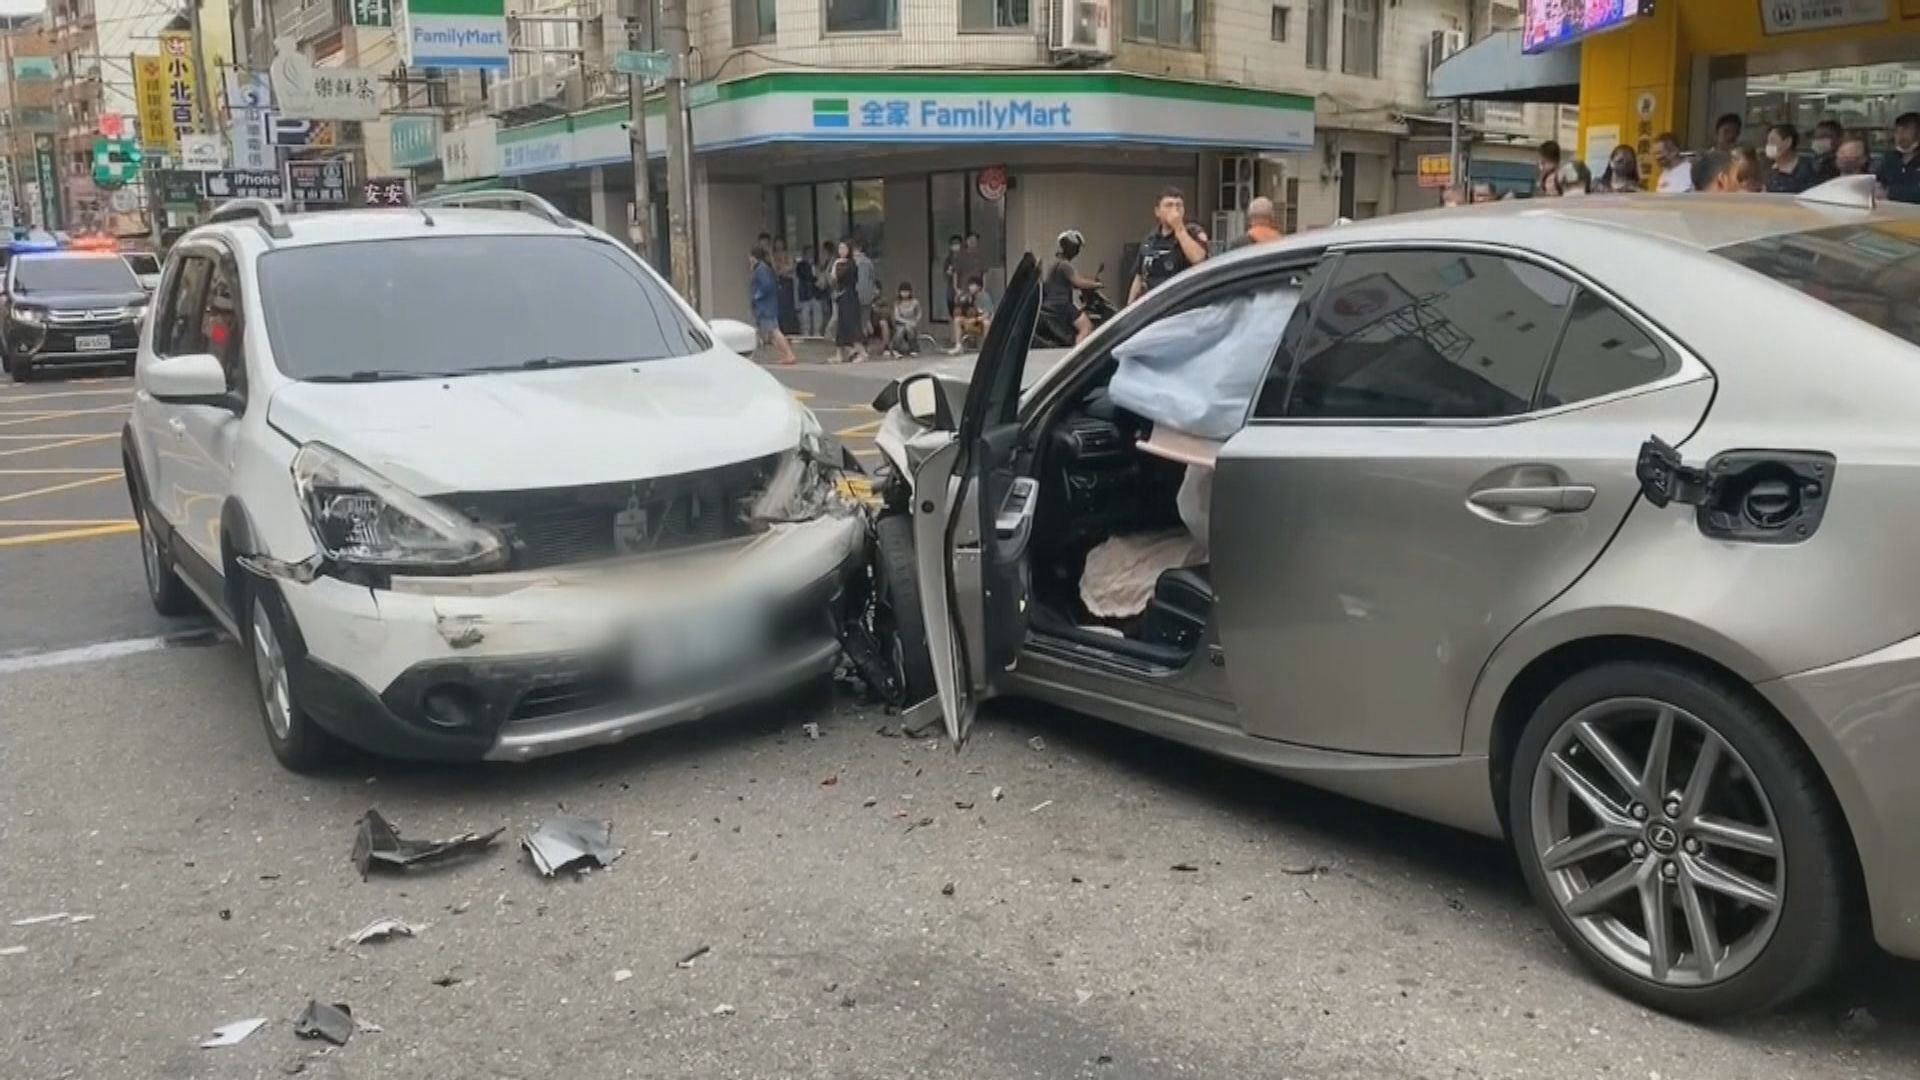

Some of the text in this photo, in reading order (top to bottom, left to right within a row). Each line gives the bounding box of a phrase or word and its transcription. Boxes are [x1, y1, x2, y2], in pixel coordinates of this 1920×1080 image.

[414, 27, 502, 47] FamilyMart
[860, 98, 1071, 131] 全家 FamilyMart
[234, 173, 280, 185] iPhone
[363, 183, 404, 204] 安安
